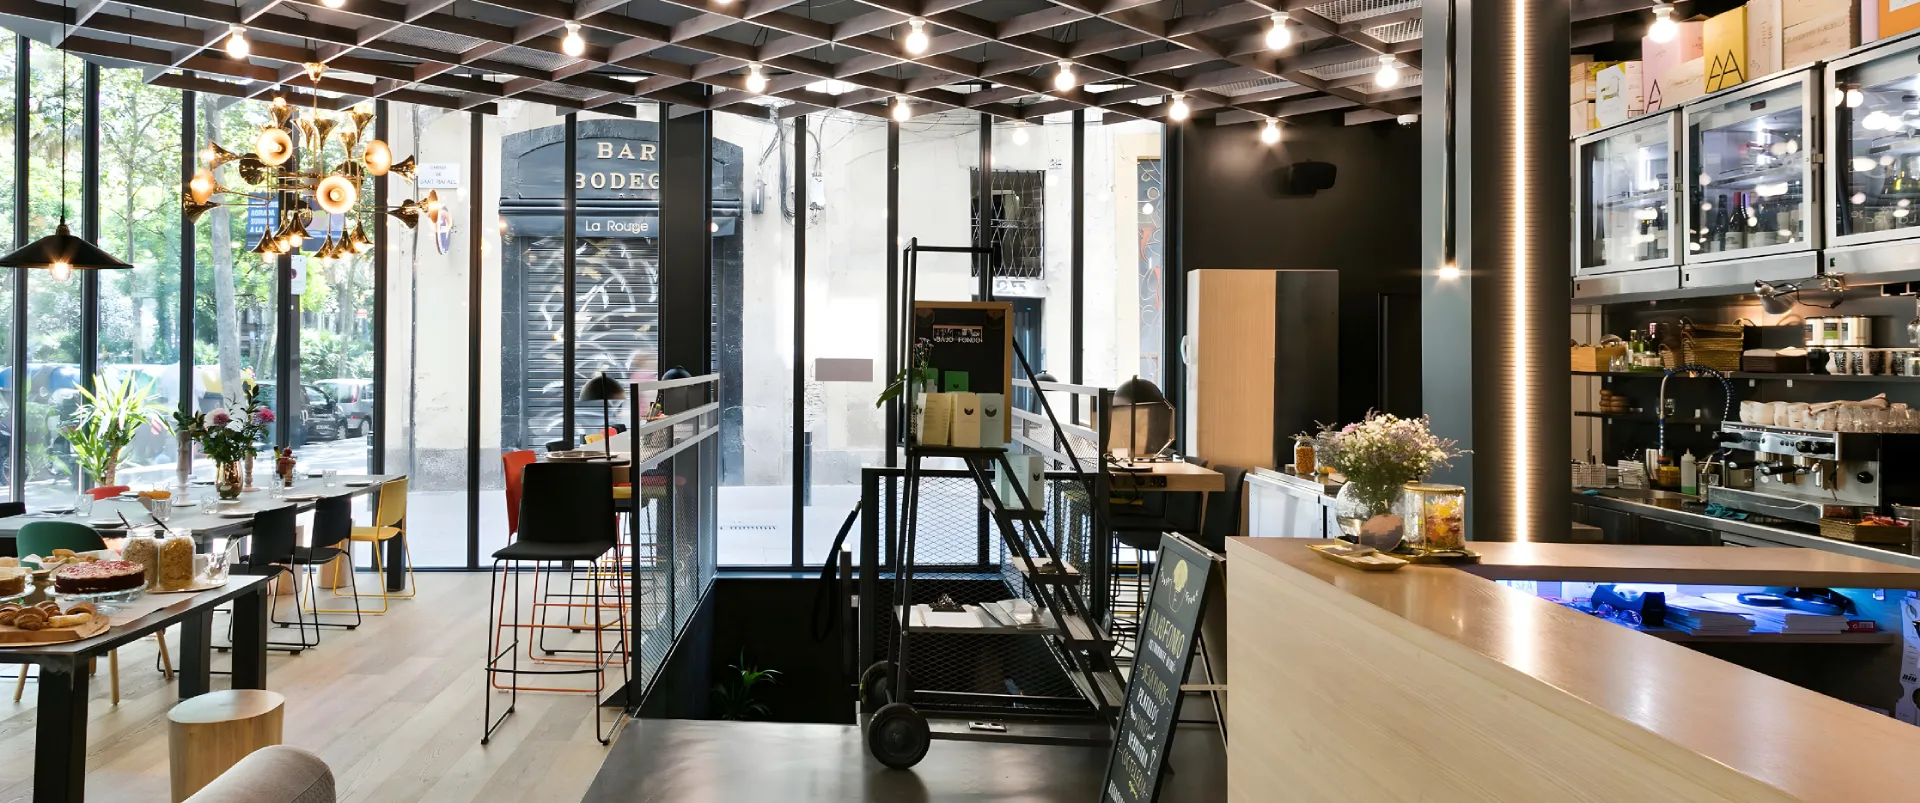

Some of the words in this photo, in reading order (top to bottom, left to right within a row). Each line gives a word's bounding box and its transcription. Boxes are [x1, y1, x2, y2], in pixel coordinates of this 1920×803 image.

[597, 142, 657, 161] BAR
[576, 172, 659, 190] BODEG
[585, 220, 601, 232] La
[607, 220, 650, 234] Rouge
